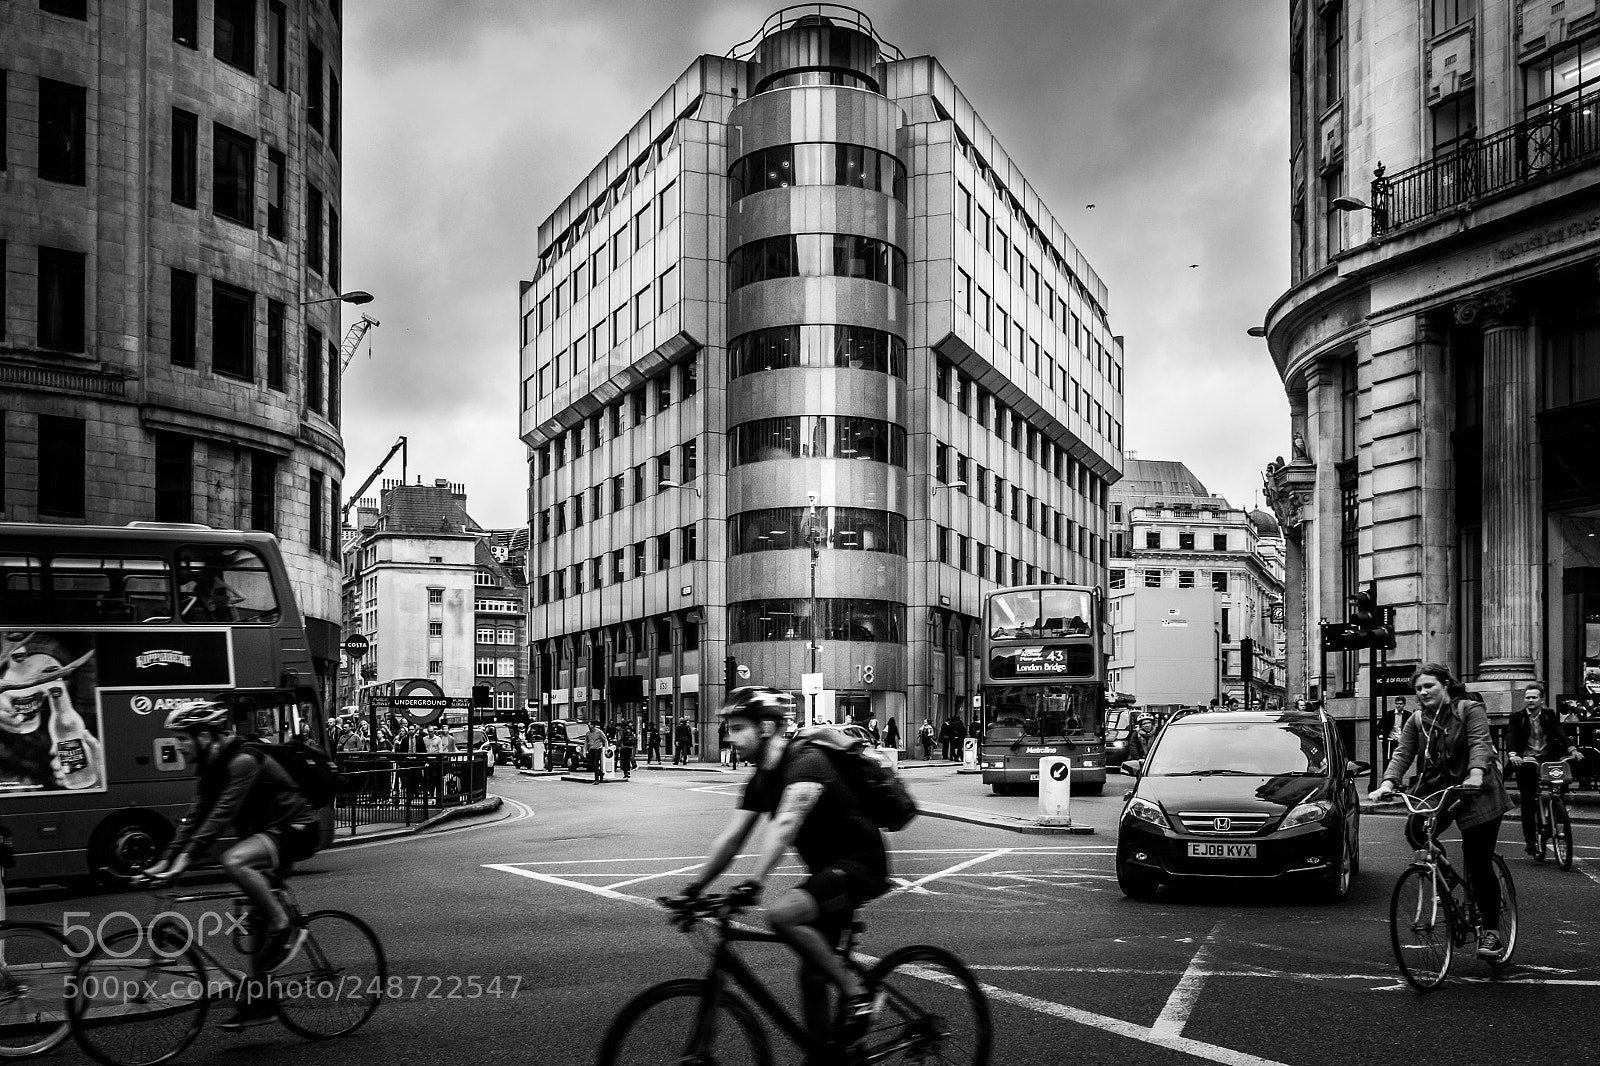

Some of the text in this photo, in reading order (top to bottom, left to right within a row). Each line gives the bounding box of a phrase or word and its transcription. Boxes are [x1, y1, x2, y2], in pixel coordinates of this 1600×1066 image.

[1046, 650, 1064, 662] 43
[855, 664, 875, 684] 18
[1016, 663, 1067, 673] London Bridge
[1192, 844, 1251, 857] EJ08 KVX
